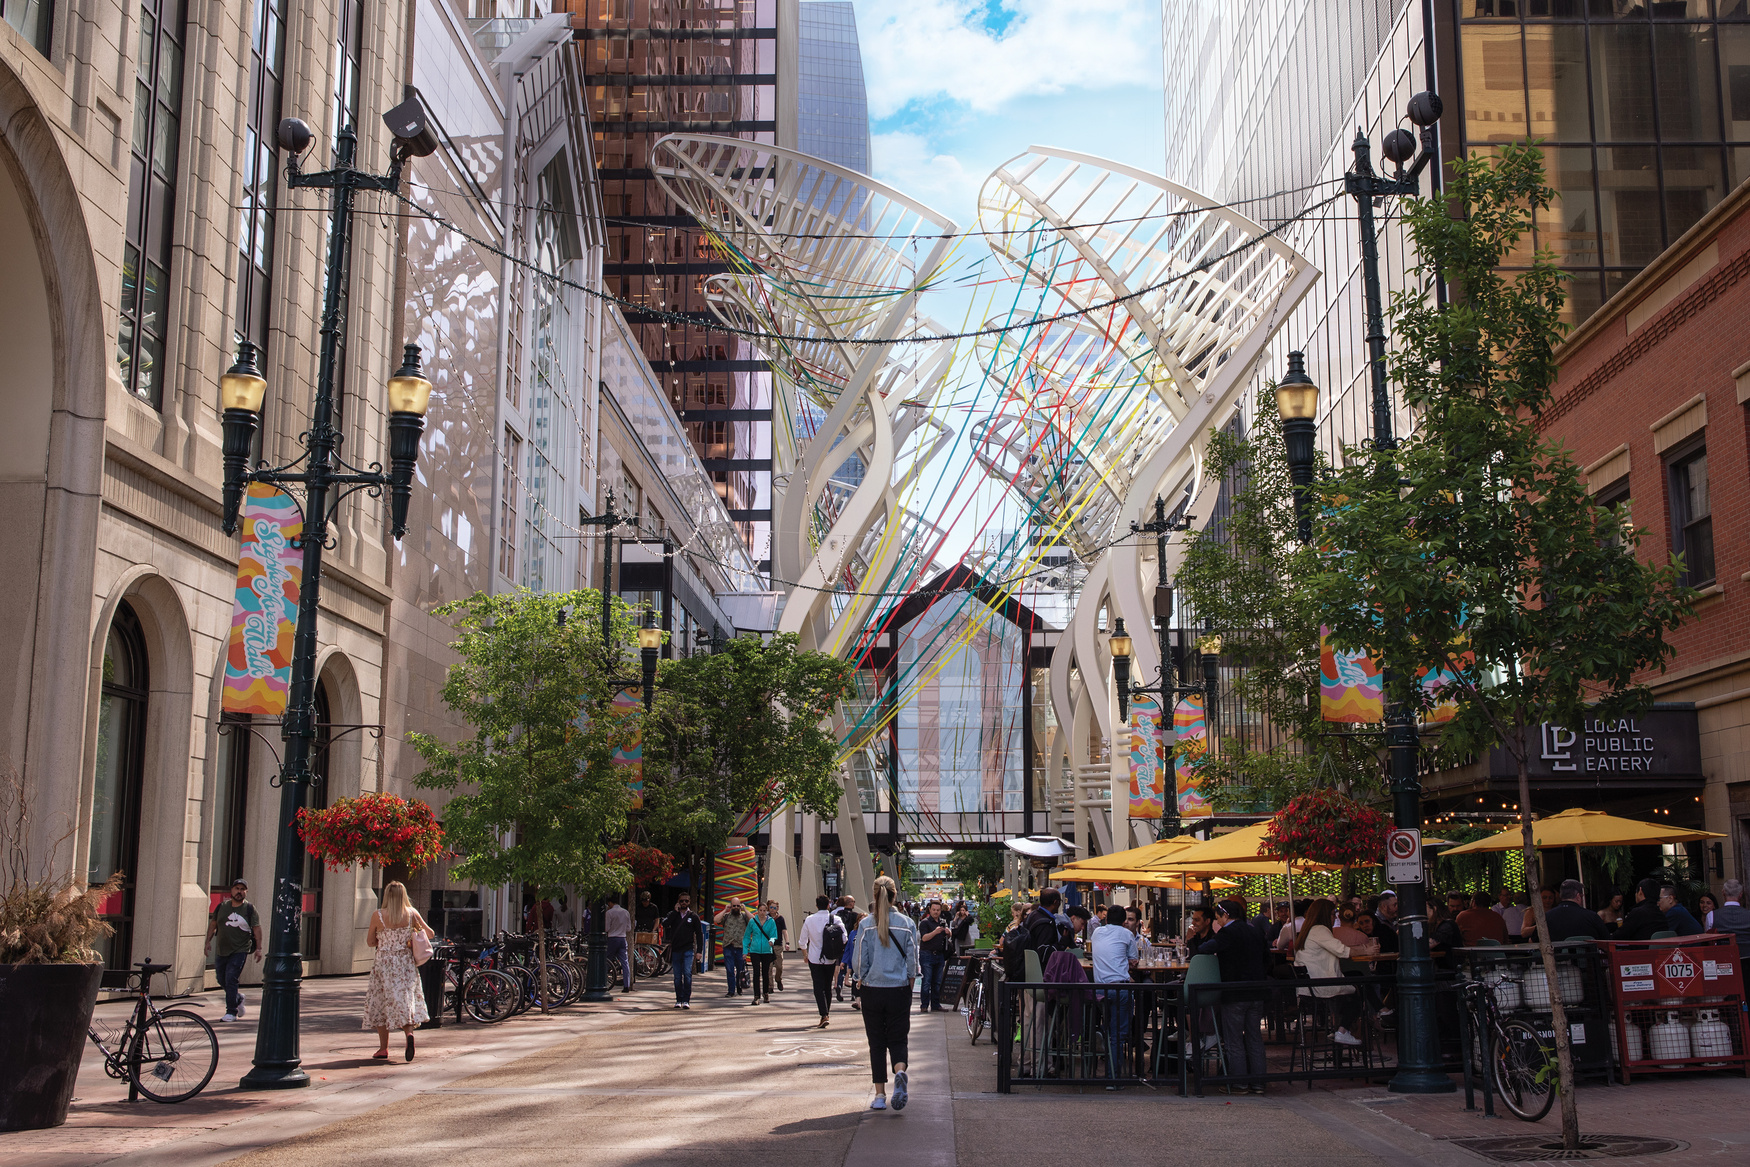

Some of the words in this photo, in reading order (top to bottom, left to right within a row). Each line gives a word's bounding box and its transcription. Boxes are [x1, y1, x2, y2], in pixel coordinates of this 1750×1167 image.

[252, 520, 291, 599] Stephen
[253, 577, 284, 649] Avenue
[244, 615, 273, 677] Walk
[1584, 718, 1641, 733] LOCAL
[1585, 737, 1654, 752] PUBLIC
[1586, 756, 1653, 771] EATERY
[1667, 964, 1693, 978] 1075
[1678, 981, 1684, 989] 2
